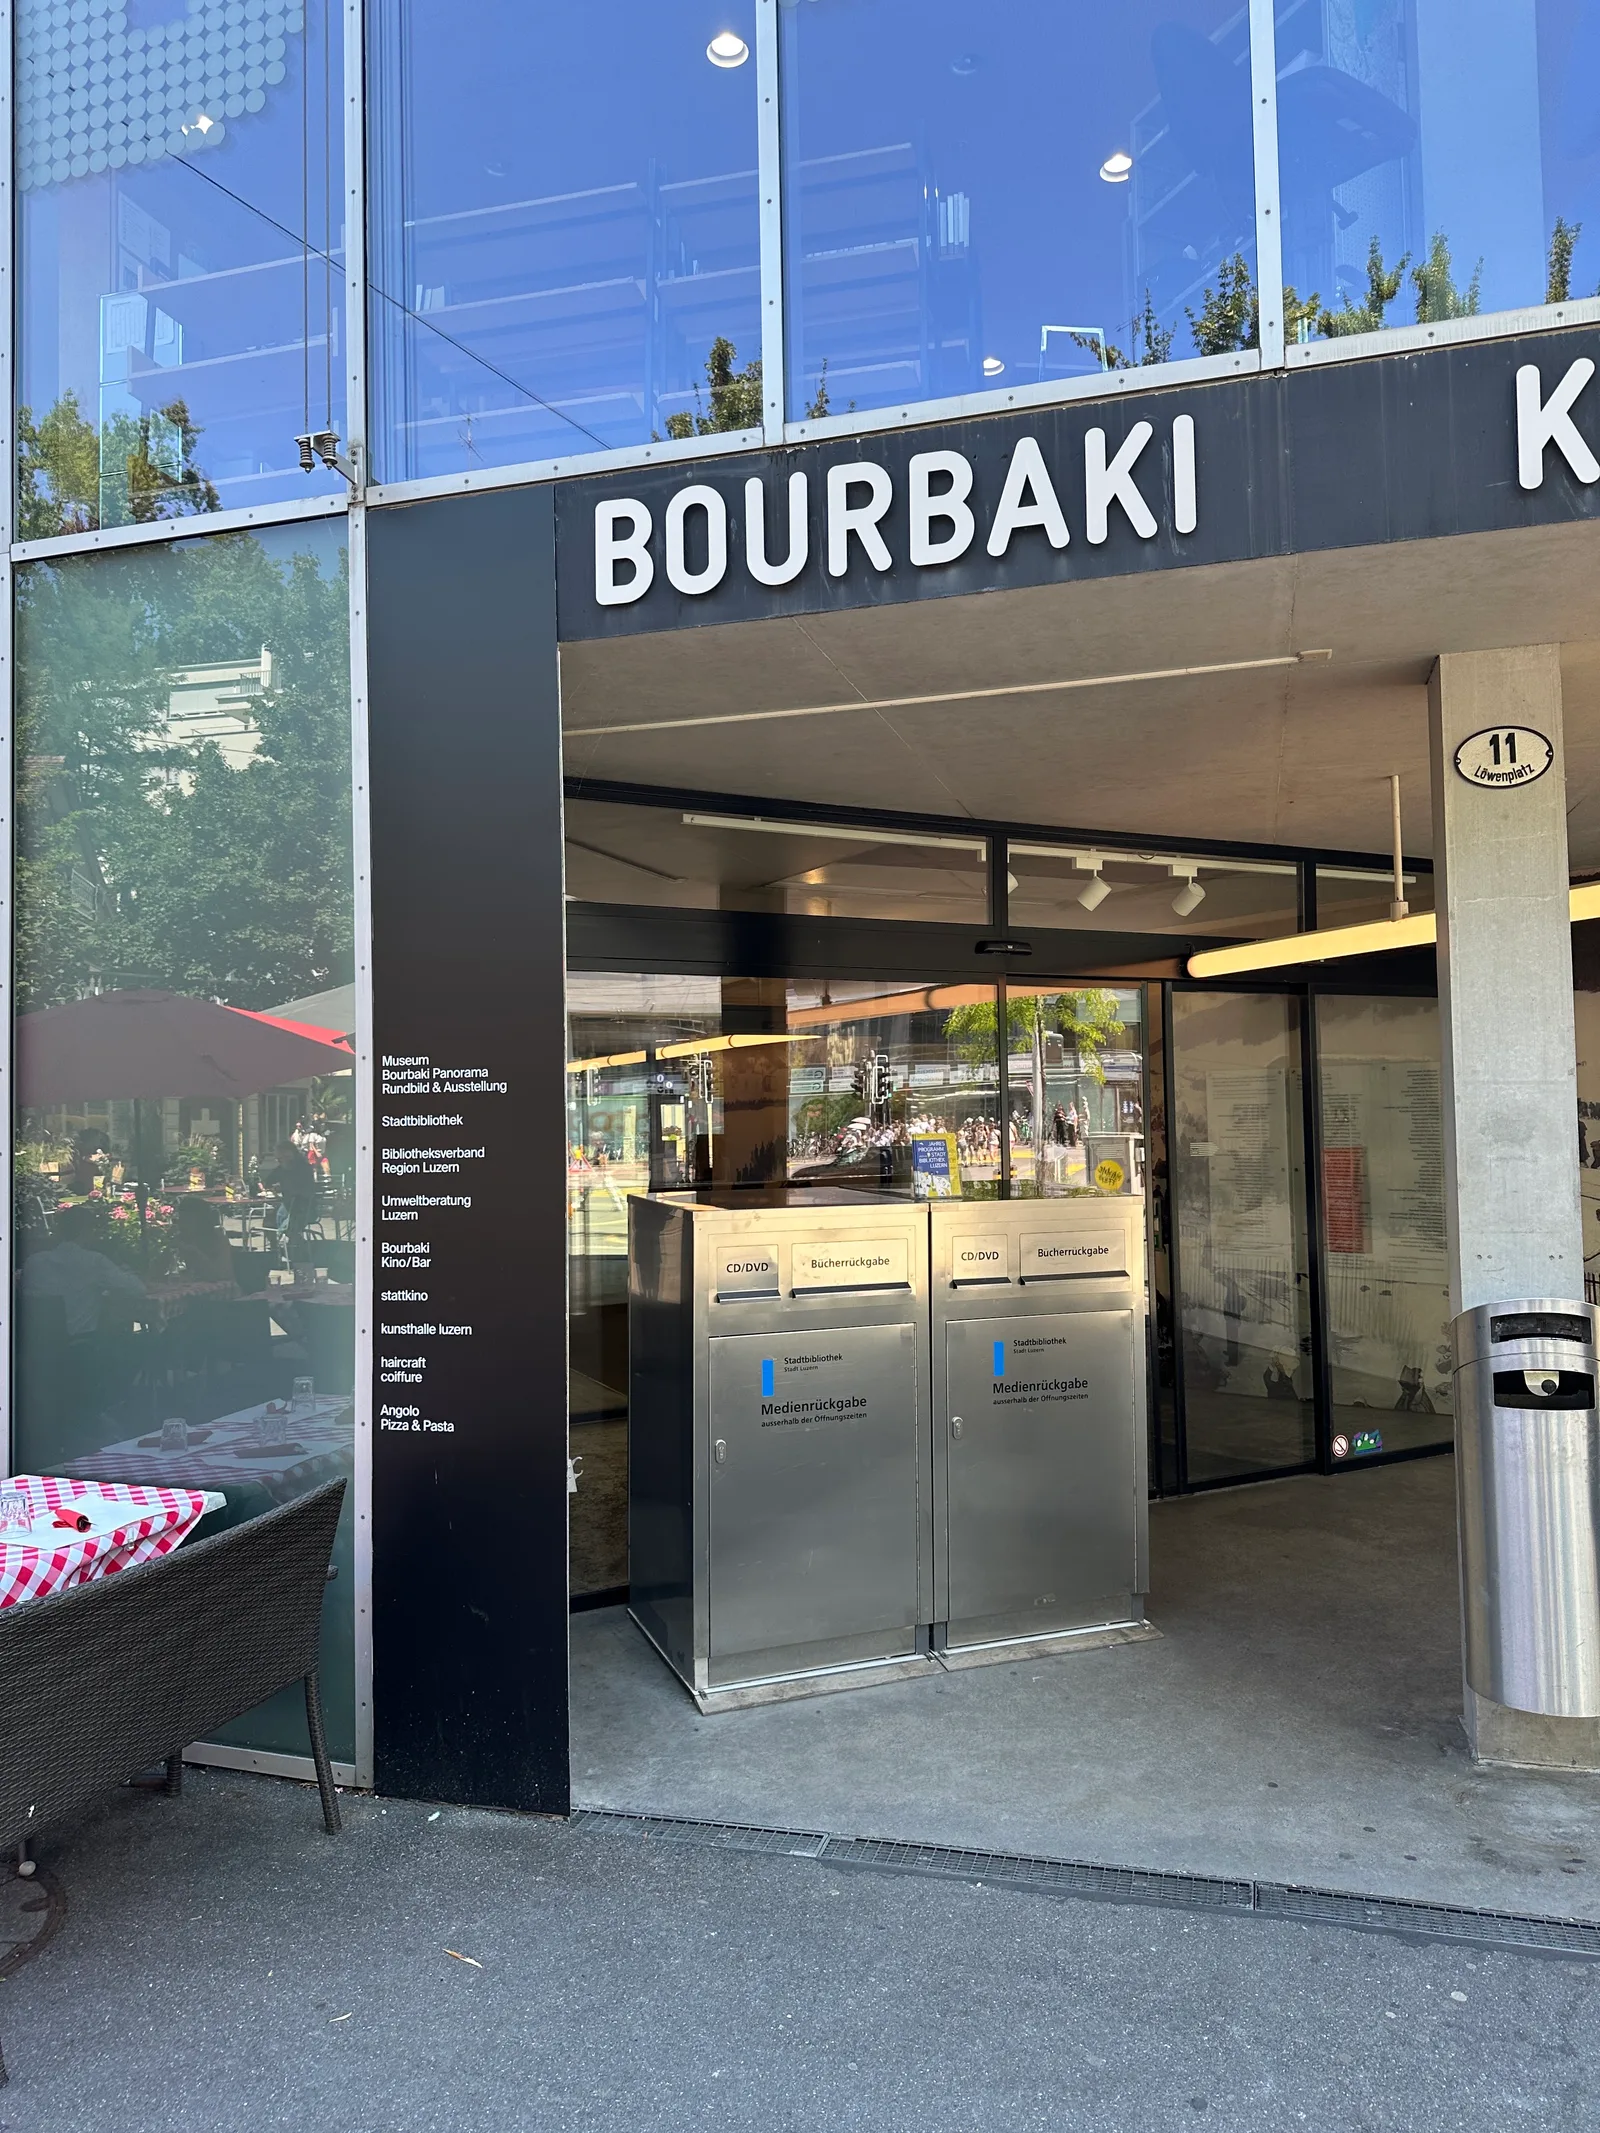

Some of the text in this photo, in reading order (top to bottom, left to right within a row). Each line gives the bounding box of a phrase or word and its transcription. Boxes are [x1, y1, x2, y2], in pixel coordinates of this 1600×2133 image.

[1515, 357, 1600, 490] K
[594, 414, 1198, 606] BOURBAKI
[1489, 732, 1517, 766] 11
[1474, 763, 1535, 785] Löwenplatz
[382, 1055, 430, 1067] Museum
[382, 1067, 489, 1081] Bourbaki Panorama
[382, 1080, 508, 1095] Rundbild & Ausstellung
[381, 1114, 464, 1127] Stadtbibliothek
[381, 1146, 485, 1160] Bibliotheksverband
[381, 1161, 460, 1176] Region Luzern
[381, 1195, 472, 1208] Umweltberatung
[381, 1209, 419, 1221] Luzern
[381, 1242, 430, 1254] Bourbaki
[961, 1246, 1109, 1261] CD/DVD Bücherrückgabe
[381, 1256, 432, 1268] Kino/Bar
[726, 1256, 890, 1273] CD/DVD Bücherrückgabe
[380, 1290, 429, 1302] stattkino
[380, 1323, 473, 1335] kunsthalle luzern
[1013, 1337, 1067, 1347] Stadtbibliothek
[380, 1356, 427, 1369] haircraft
[784, 1353, 843, 1365] Stadtbibliothek
[380, 1371, 423, 1383] coiffure
[992, 1377, 1089, 1395] Medienrückgabe
[761, 1396, 867, 1416] Medienrückgabe
[992, 1396, 1028, 1405] ausserhalb
[380, 1404, 420, 1418] Angolo
[380, 1419, 455, 1433] Pizza & Pasta
[761, 1417, 800, 1428] ausserhalb
[800, 1416, 813, 1424] der
